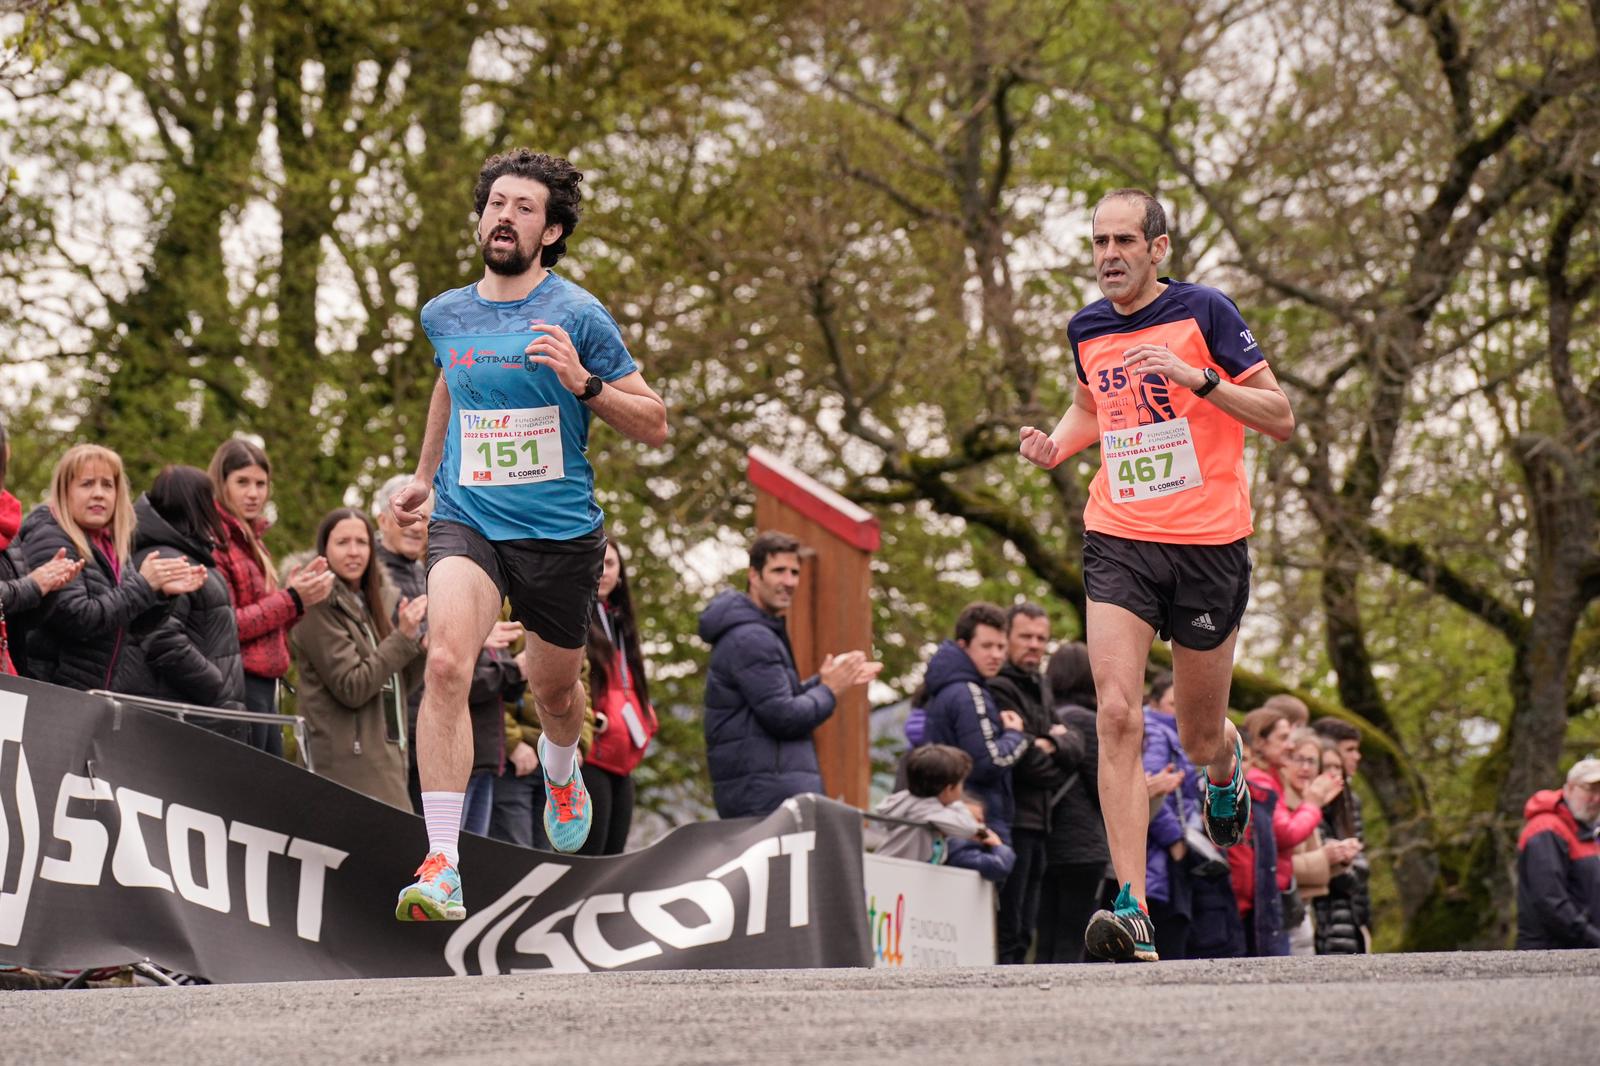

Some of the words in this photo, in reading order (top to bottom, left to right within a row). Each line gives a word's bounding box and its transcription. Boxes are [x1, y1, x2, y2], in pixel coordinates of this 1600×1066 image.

[448, 347, 476, 369] 34
[475, 355, 522, 364] ESTIBALIZ
[1098, 366, 1127, 393] 35
[464, 414, 510, 430] Vital
[480, 431, 522, 439] ESTIBALIZ
[523, 427, 556, 437] IGOERA
[1105, 431, 1143, 450] Vital
[476, 439, 539, 468] 151
[1118, 445, 1157, 458] ESTIBALIZ
[1157, 439, 1188, 450] IGOERA
[518, 468, 547, 477] CORREO
[1118, 451, 1174, 485] 467
[1149, 484, 1157, 492] EL
[1157, 479, 1185, 490] CORREO
[1191, 619, 1216, 631] adidas
[39, 772, 350, 942] SCOTT
[510, 830, 816, 973] SCOTT
[868, 893, 904, 966] tal
